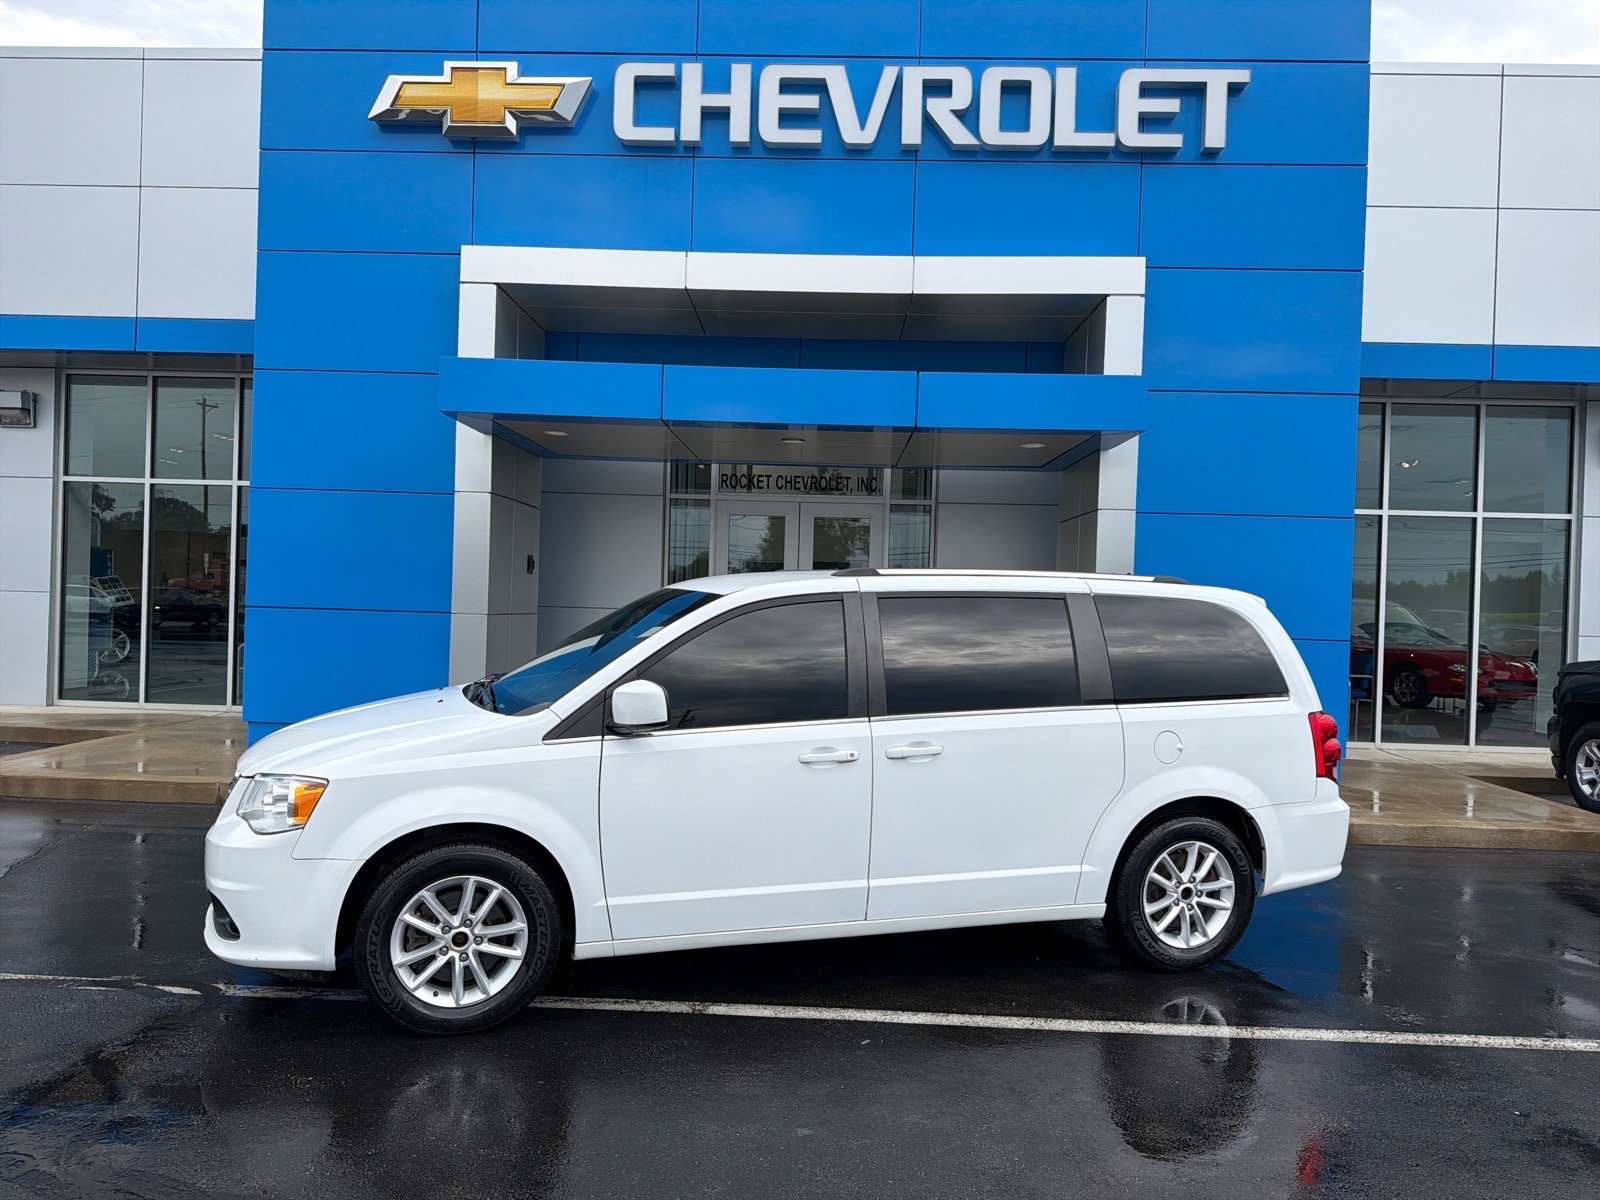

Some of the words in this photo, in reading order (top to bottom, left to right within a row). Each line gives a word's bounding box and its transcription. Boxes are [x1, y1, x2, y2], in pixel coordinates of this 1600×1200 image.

[613, 62, 1251, 152] CHEVROLET
[720, 473, 772, 490] ROCKET
[775, 475, 853, 494] CHEVROLET,
[857, 476, 881, 493] INC.
